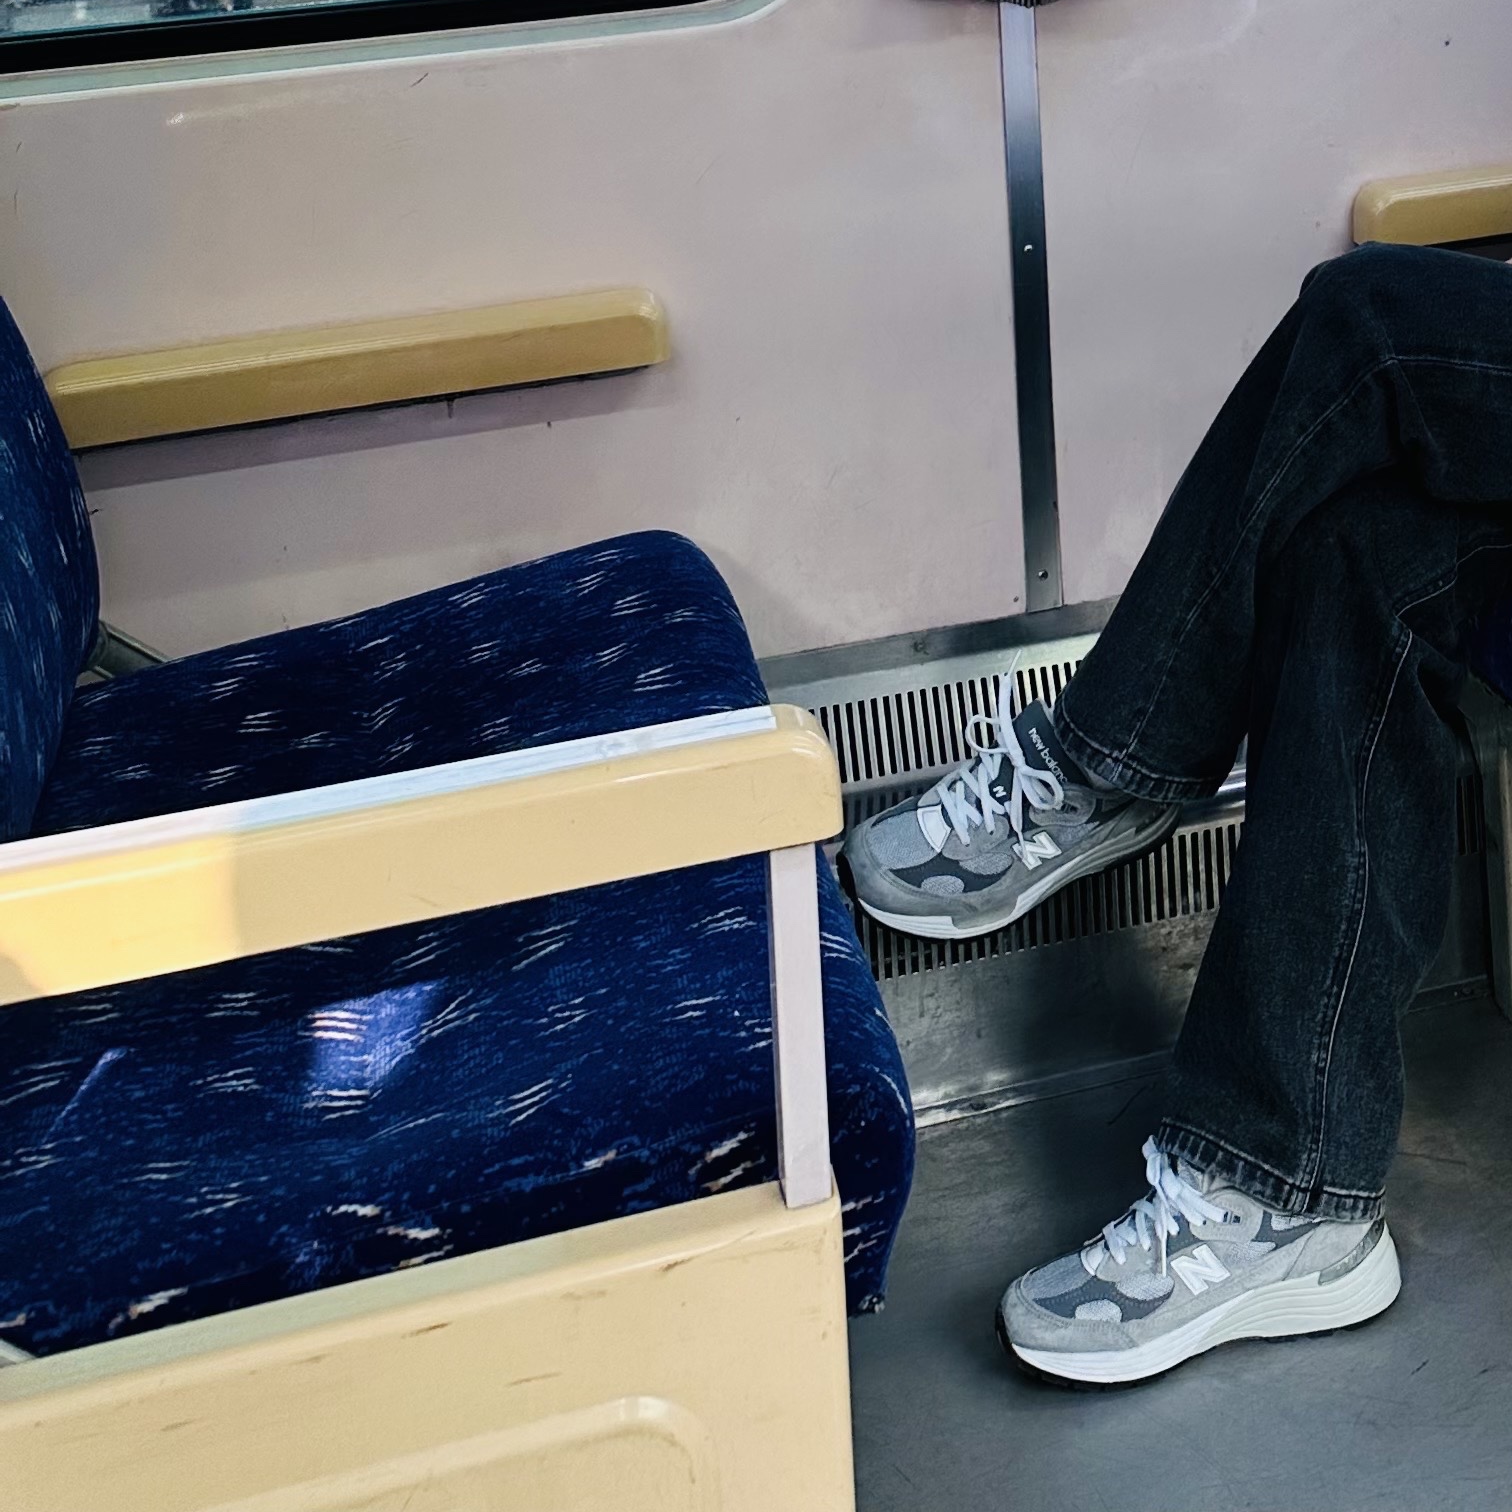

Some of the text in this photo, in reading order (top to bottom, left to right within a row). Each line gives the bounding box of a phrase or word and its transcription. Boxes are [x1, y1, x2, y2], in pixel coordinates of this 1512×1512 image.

[1028, 727, 1068, 784] new balanc
[1011, 831, 1062, 871] N
[1170, 1243, 1232, 1296] N
